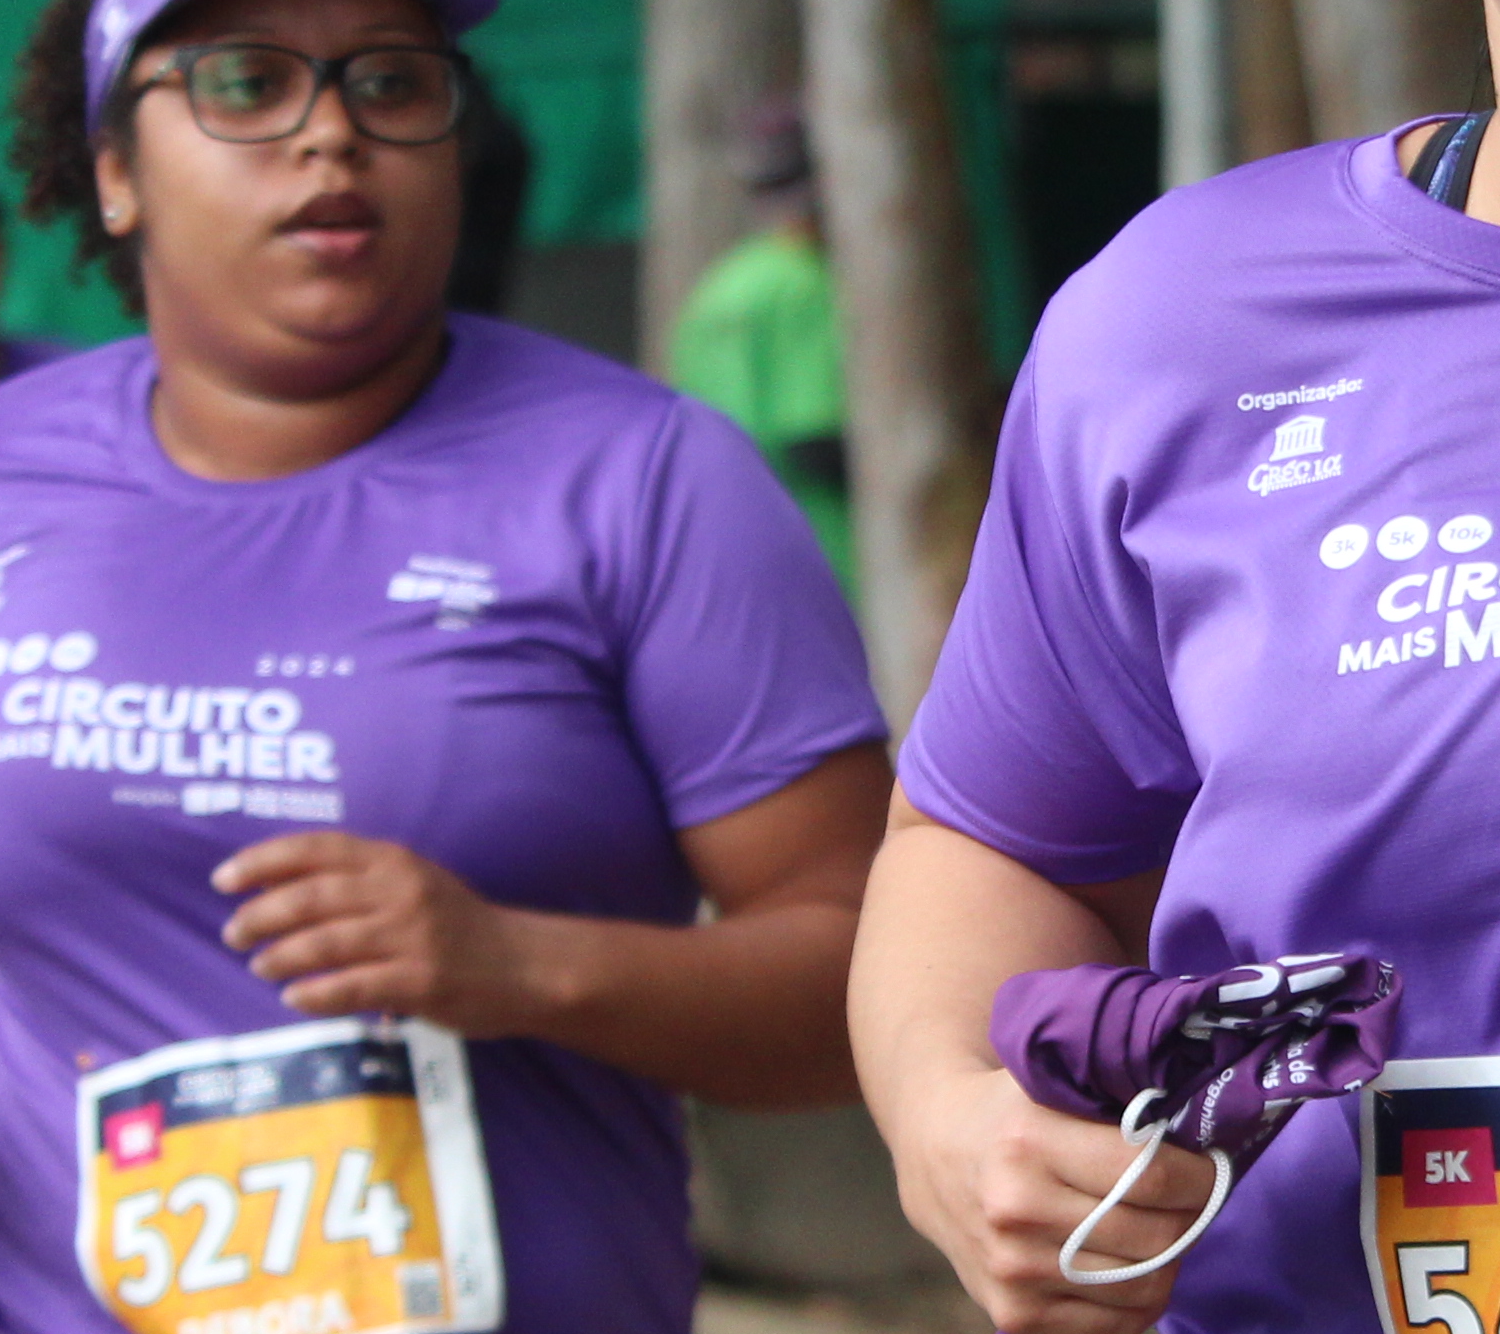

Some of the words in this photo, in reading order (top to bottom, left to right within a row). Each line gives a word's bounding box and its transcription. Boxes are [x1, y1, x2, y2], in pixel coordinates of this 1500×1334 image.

[1237, 378, 1364, 411] Organização:
[1337, 627, 1436, 675] MAIS
[2, 679, 302, 735] CIRCUITO
[52, 726, 341, 782] MULHER
[1424, 1149, 1472, 1185] 5K
[112, 1147, 414, 1309] 5274
